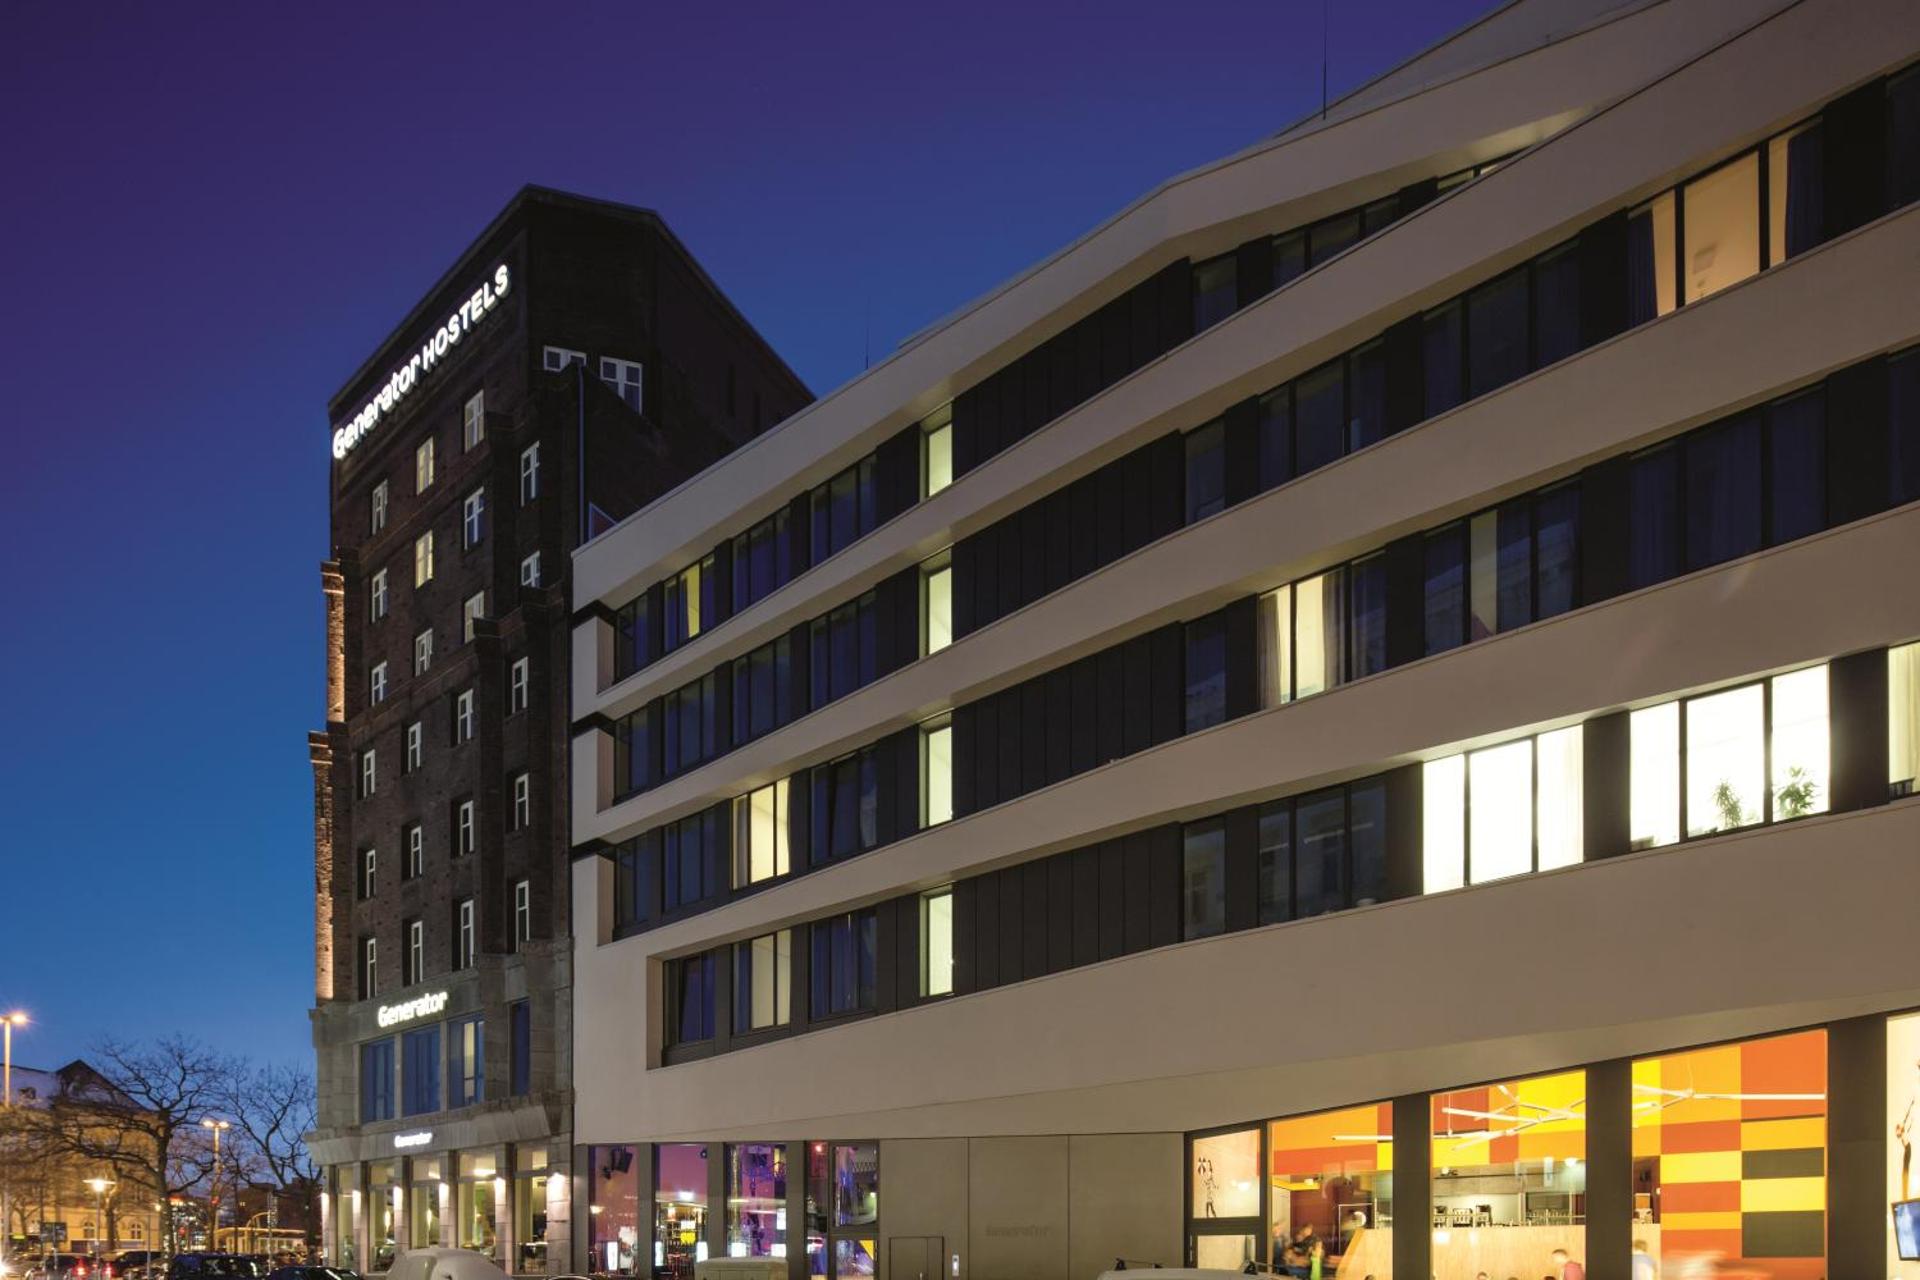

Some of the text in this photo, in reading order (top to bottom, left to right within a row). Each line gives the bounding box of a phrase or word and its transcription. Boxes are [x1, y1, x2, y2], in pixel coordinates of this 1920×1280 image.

[332, 264, 508, 459] Generator HOSTELS
[377, 991, 448, 1028] Generator
